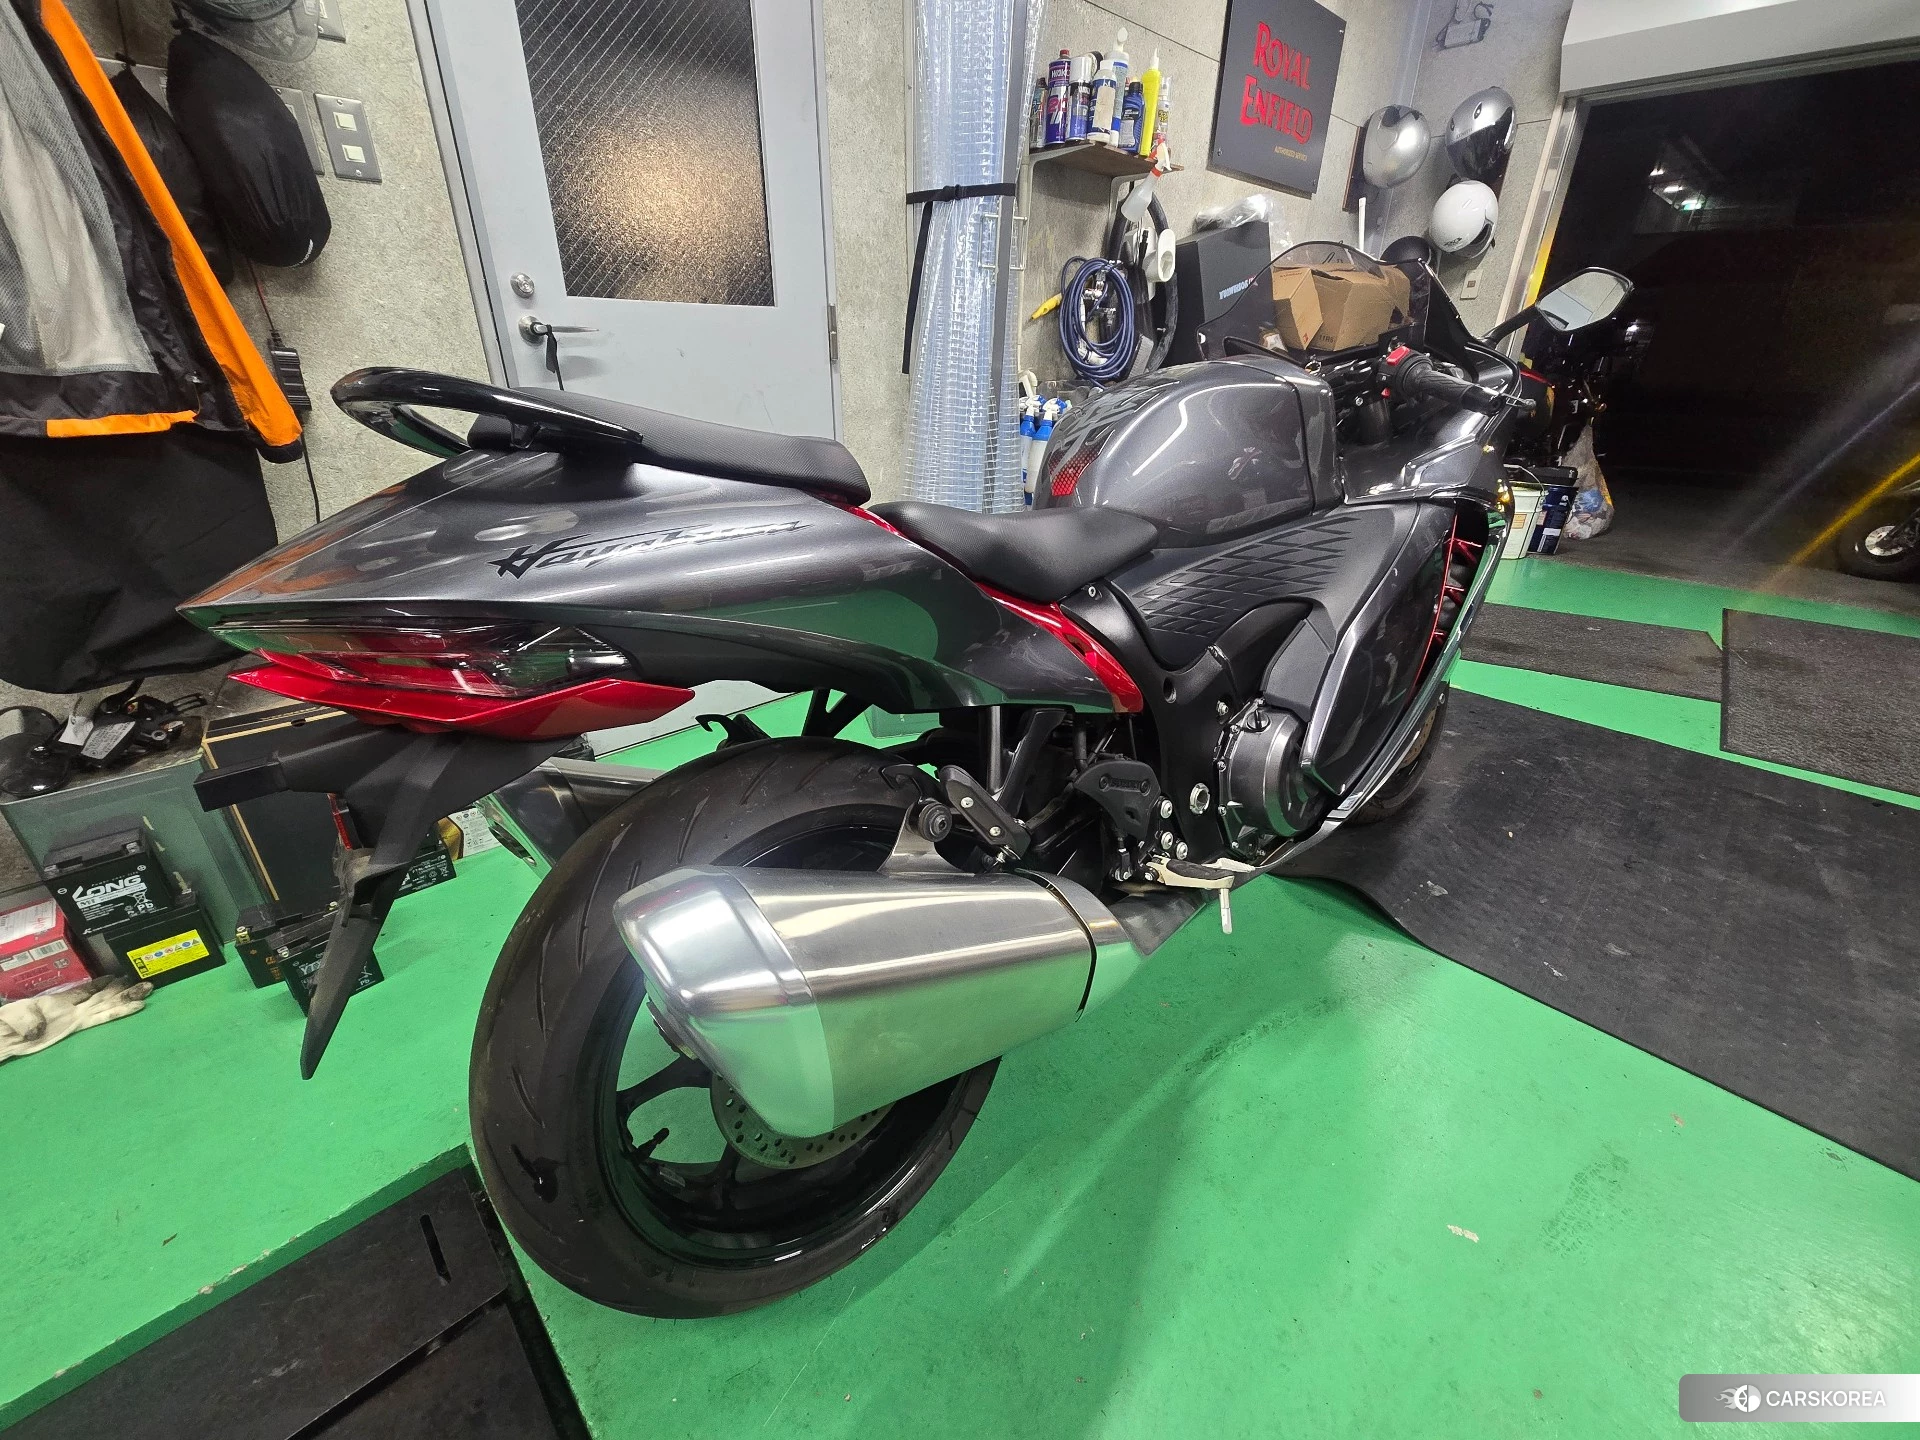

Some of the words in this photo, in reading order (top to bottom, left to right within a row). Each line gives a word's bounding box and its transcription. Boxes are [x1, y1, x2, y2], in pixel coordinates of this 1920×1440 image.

[1253, 21, 1311, 91] ROYAL
[1240, 74, 1313, 145] ENFIELD
[72, 874, 142, 901] LONG
